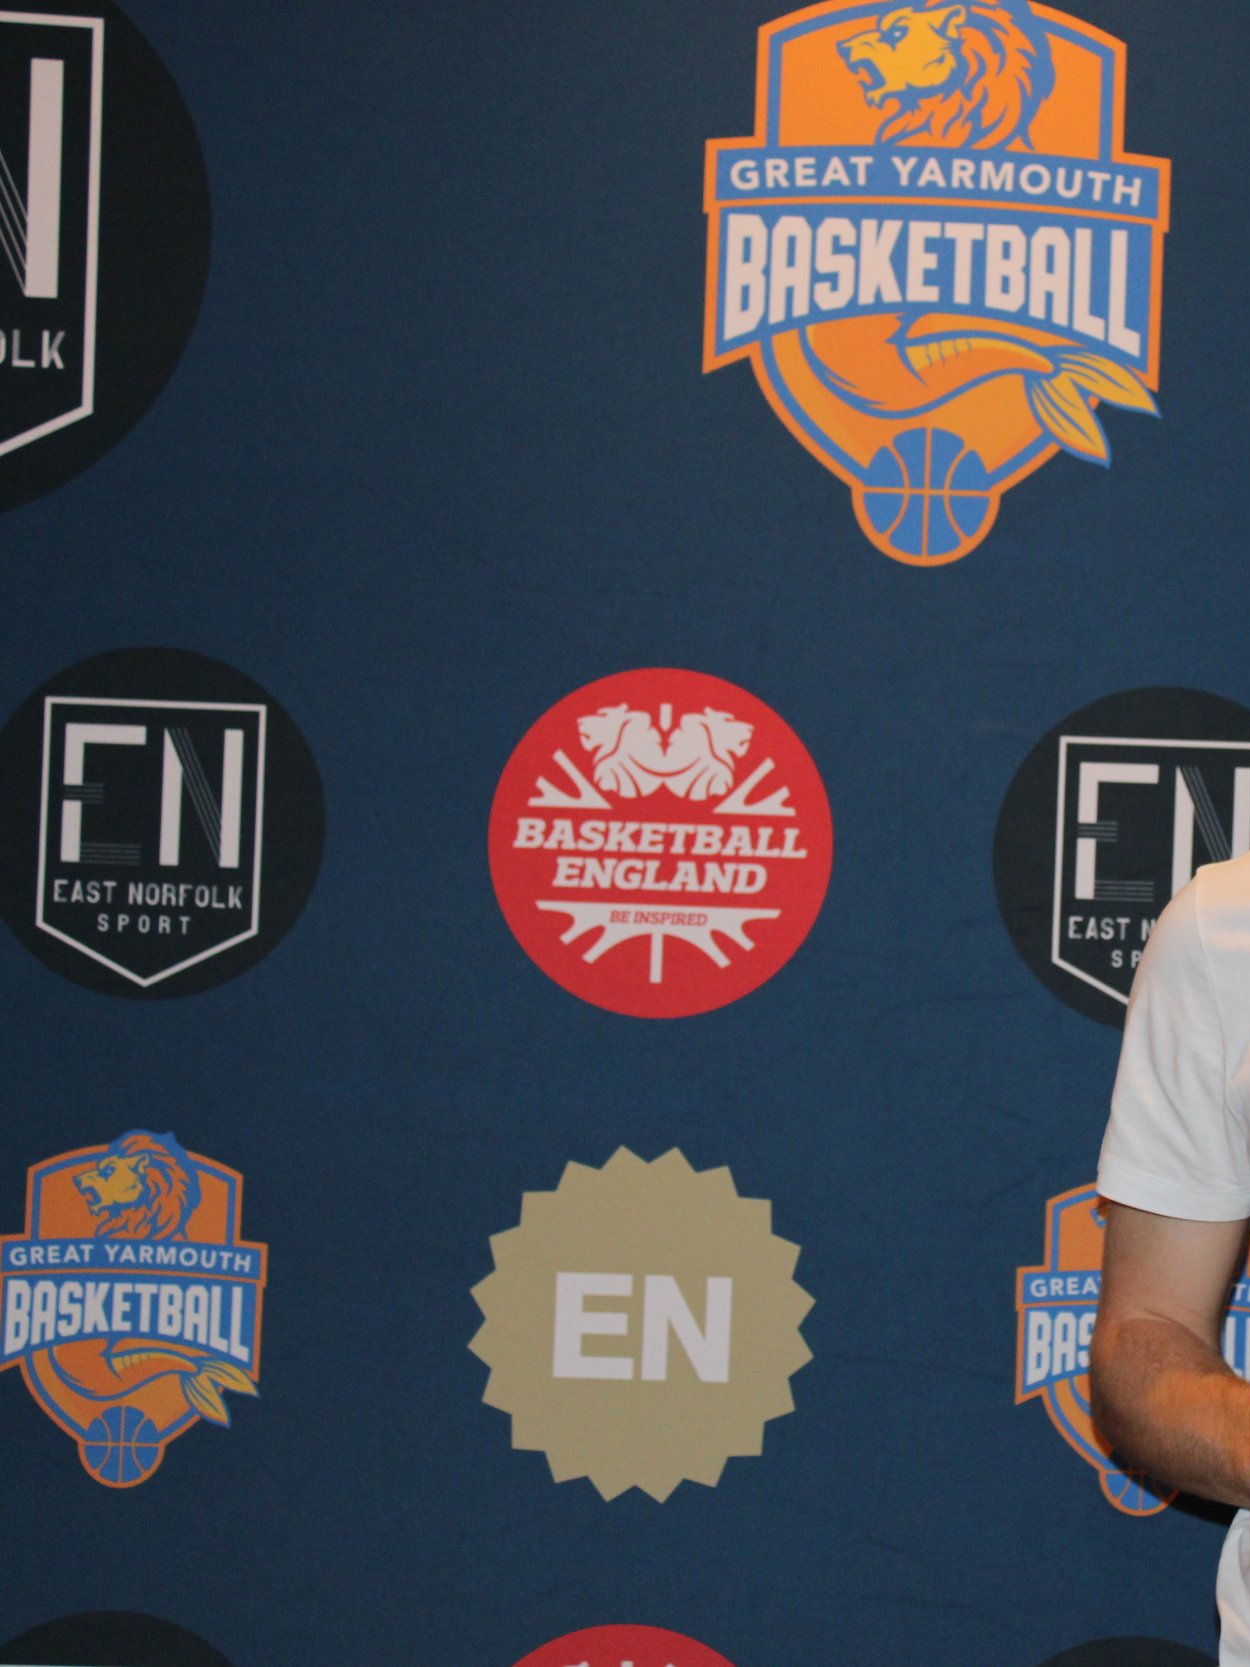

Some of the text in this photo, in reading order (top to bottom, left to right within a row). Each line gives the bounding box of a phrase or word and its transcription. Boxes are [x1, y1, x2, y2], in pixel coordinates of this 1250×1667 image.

[730, 156, 1142, 207] GREAT YARMOUTH
[723, 213, 1141, 358] BASKETBALL
[513, 817, 808, 859] BASKETBALL
[552, 856, 767, 894] ENGLAND
[53, 879, 243, 910] EAST NORFOLK
[97, 913, 191, 935] SPORT
[610, 910, 708, 926] BE INSPIRED
[1068, 916, 1131, 941] EAST
[9, 1244, 251, 1273] GREAT YARMOUTH
[1030, 1276, 1103, 1297] GREA
[4, 1279, 250, 1363] BASKETBALL
[552, 1271, 733, 1383] EN
